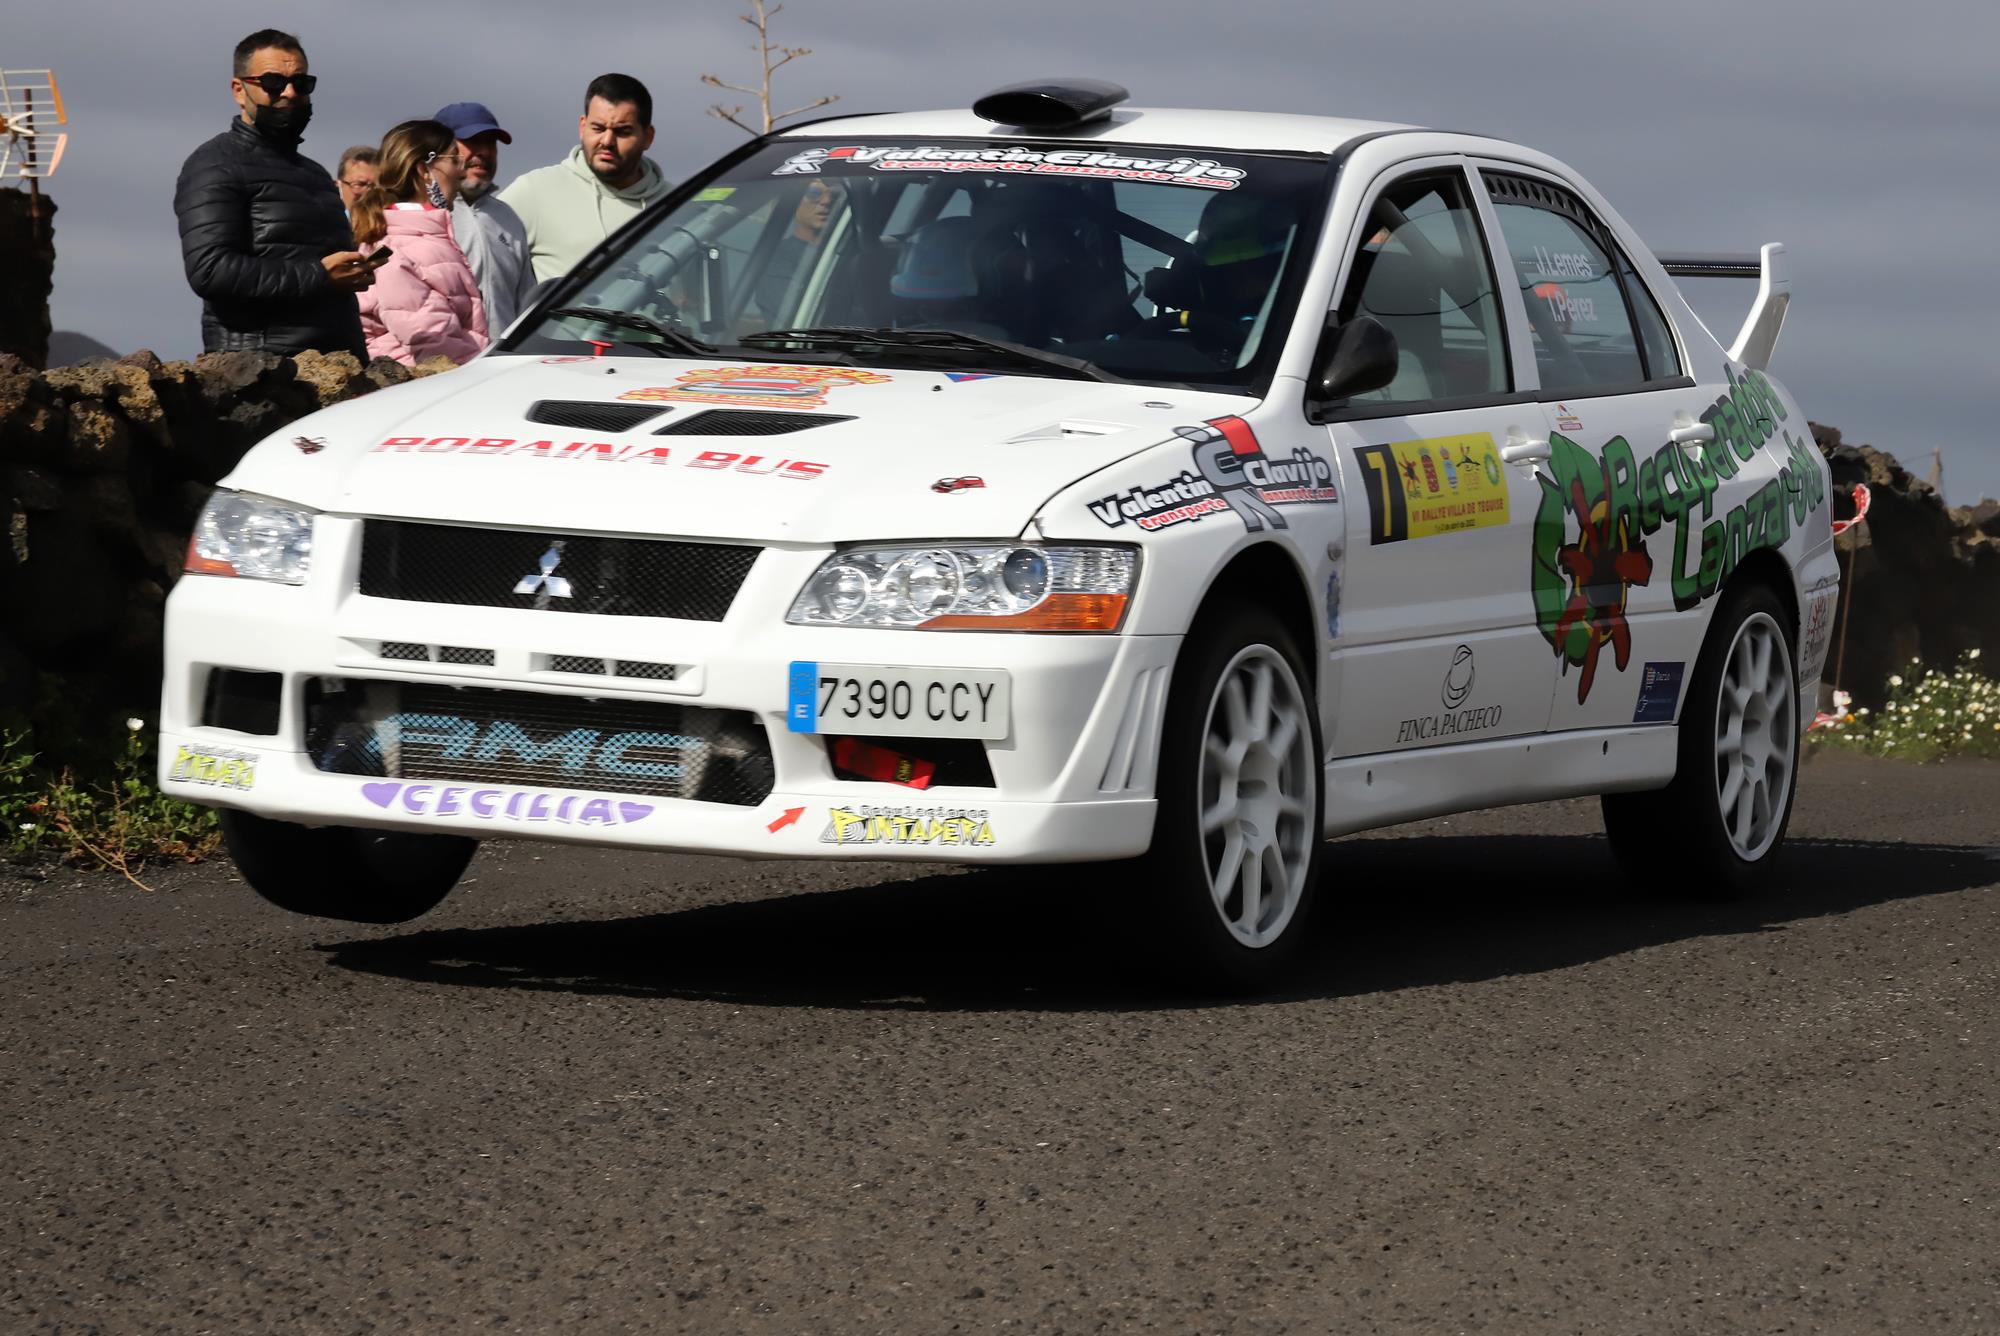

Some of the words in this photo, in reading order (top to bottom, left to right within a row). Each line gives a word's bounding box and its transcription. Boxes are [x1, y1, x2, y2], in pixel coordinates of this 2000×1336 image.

[370, 436, 670, 465] ROBAINA
[684, 450, 831, 481] BUS
[1090, 473, 1216, 526] Valentin
[1243, 449, 1330, 488] Clavijo
[1139, 497, 1228, 530] transporte
[793, 704, 809, 719] E
[819, 677, 912, 720] 7390
[927, 682, 994, 723] CCY
[1396, 716, 1438, 743] FINCA
[1440, 705, 1502, 735] PACHECO
[402, 784, 617, 826] CECILIA
